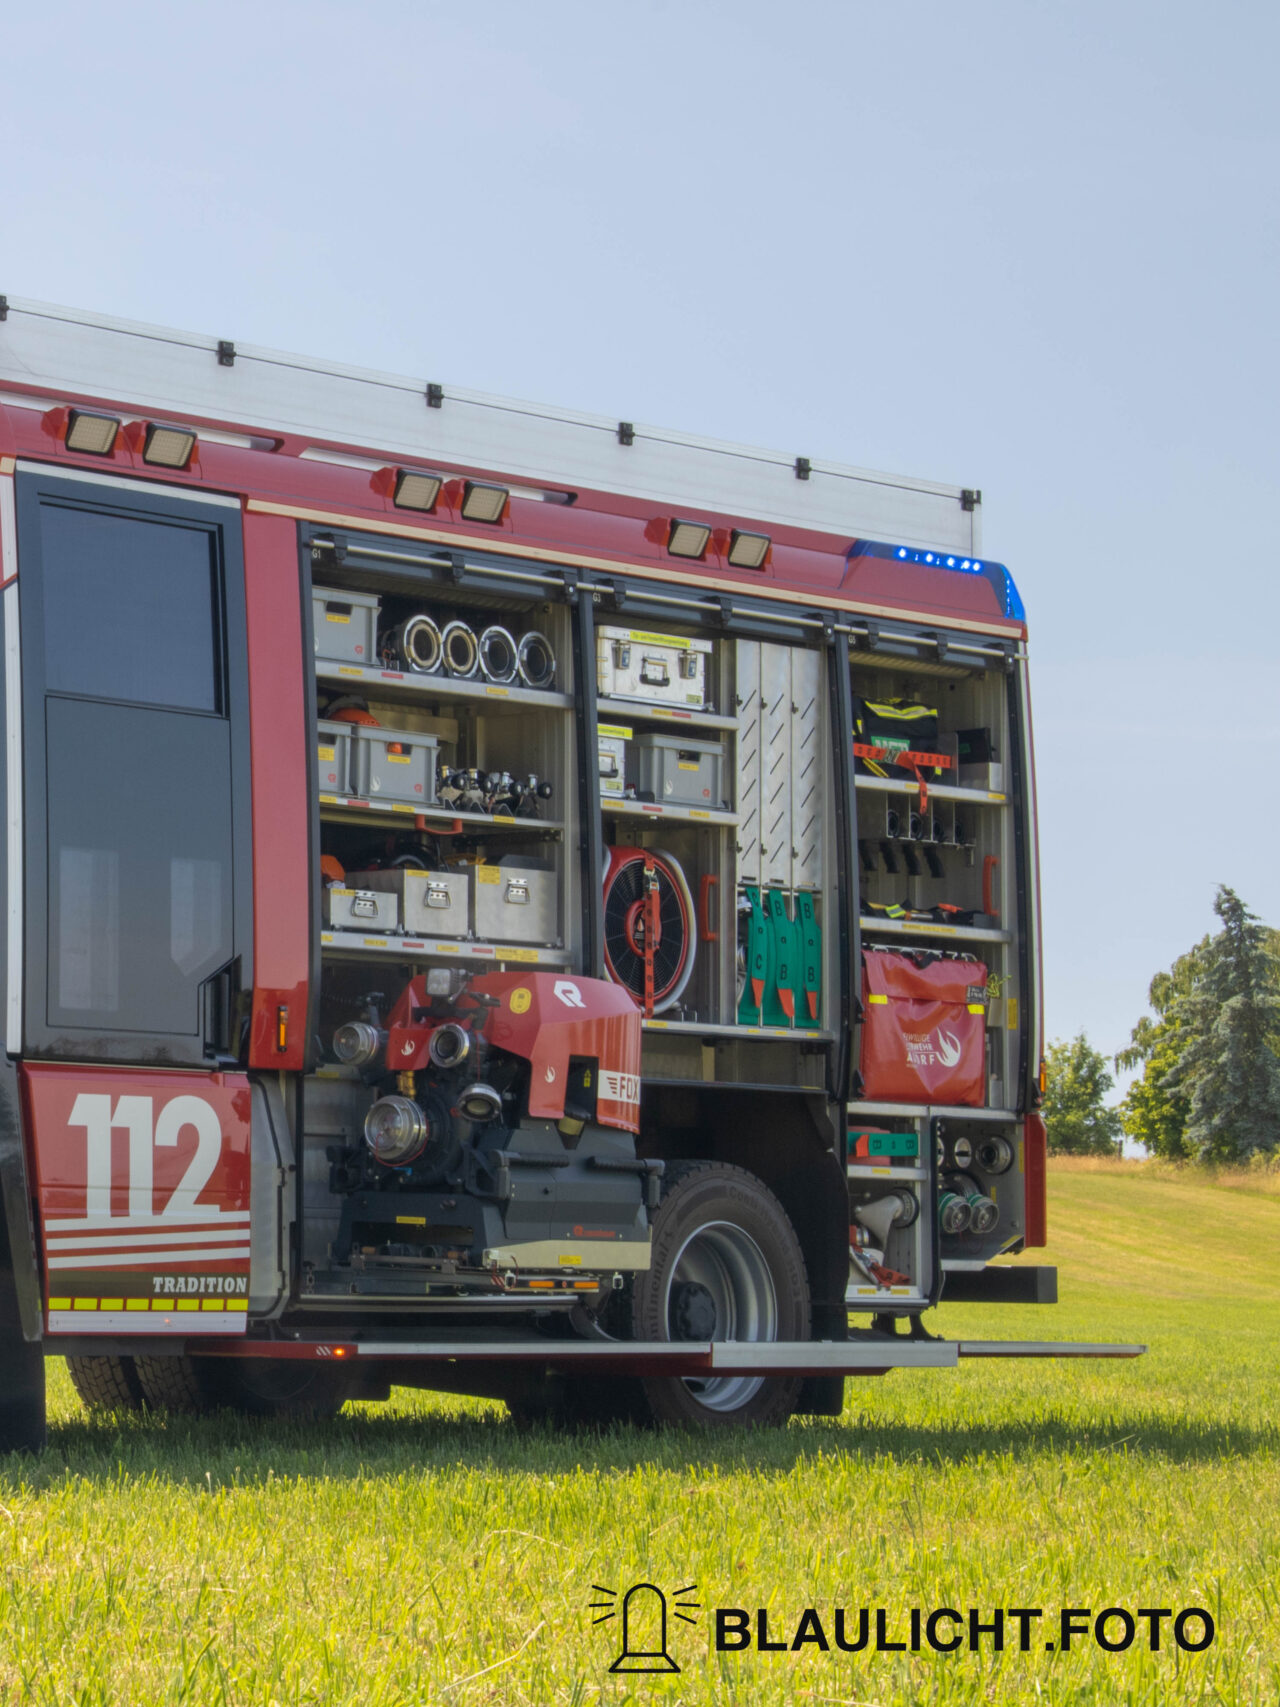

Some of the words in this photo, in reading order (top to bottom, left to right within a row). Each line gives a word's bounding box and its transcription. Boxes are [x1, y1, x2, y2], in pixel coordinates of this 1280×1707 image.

[312, 548, 322, 559] G1
[619, 1075, 639, 1103] FOX
[67, 1093, 222, 1218] 112
[153, 1277, 247, 1293] TRADITION
[647, 1240, 669, 1341] ntinental
